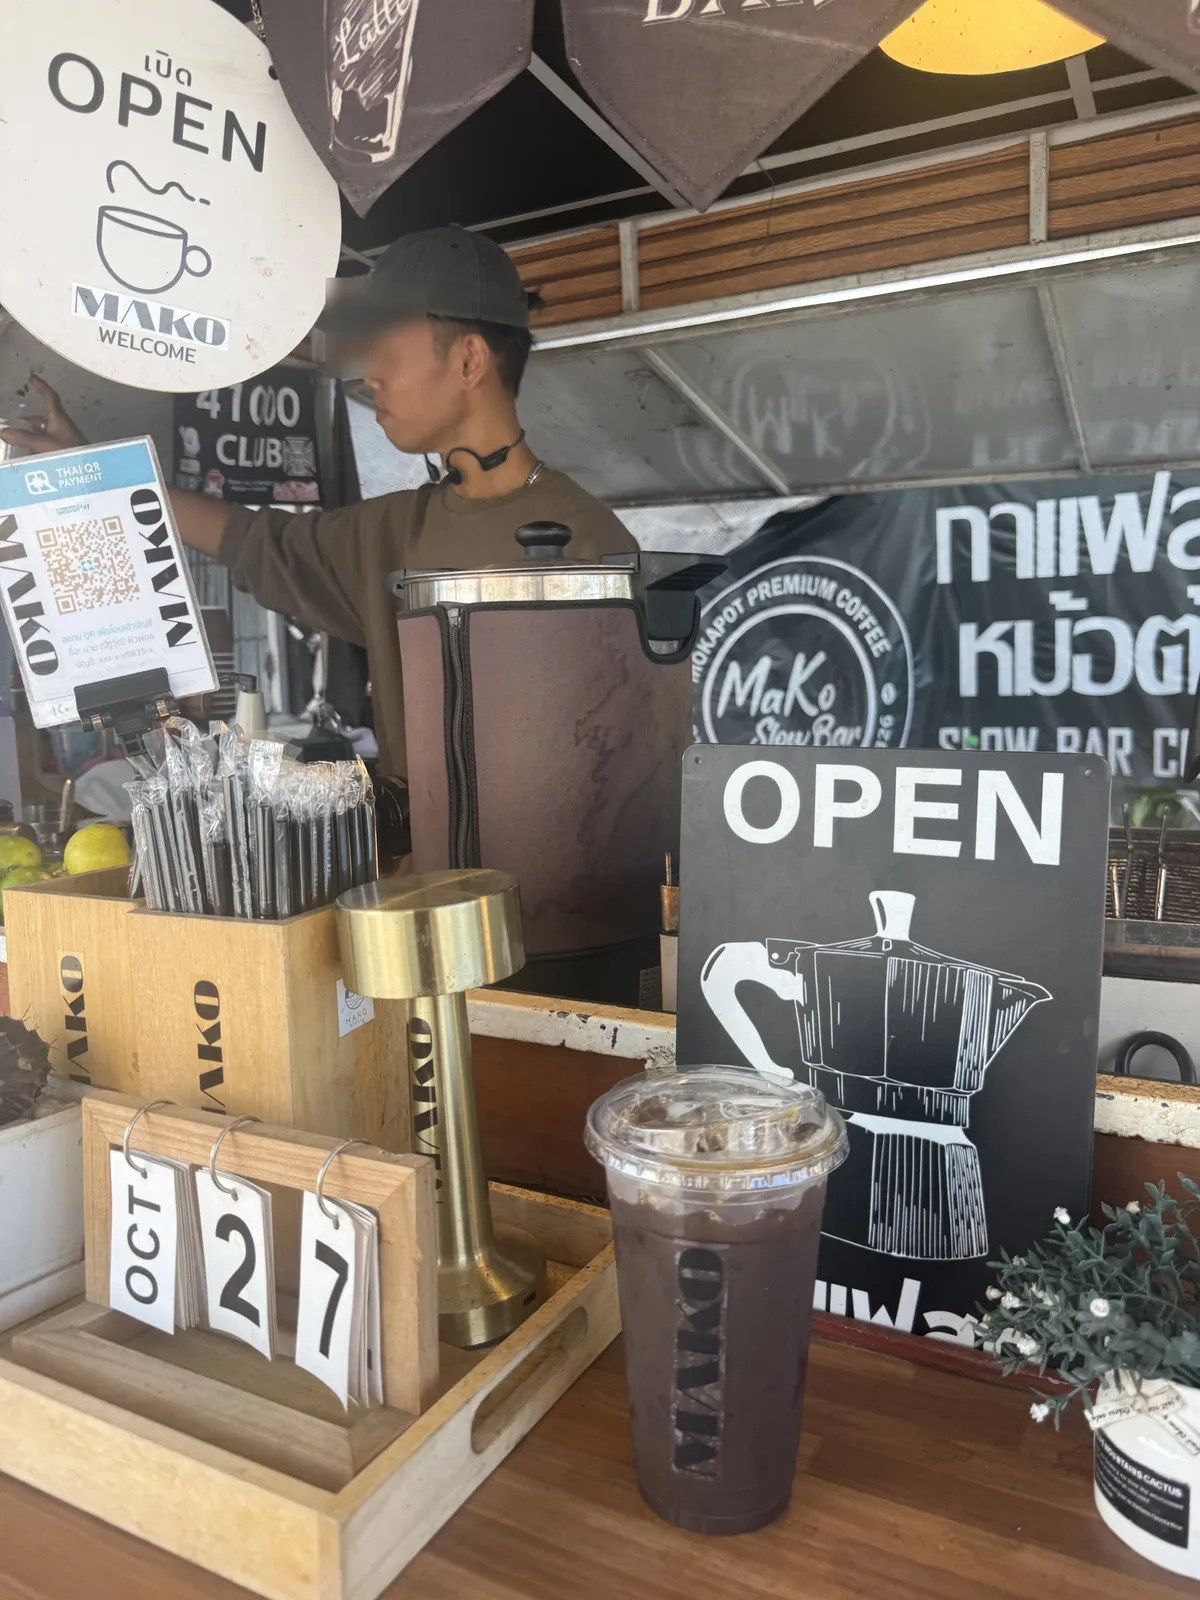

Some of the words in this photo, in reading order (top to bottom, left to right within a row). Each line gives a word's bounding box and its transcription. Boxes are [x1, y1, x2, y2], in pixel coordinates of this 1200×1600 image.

[144, 50, 192, 87] เปิด
[48, 52, 266, 173] OPEN
[74, 286, 226, 346] MAKO
[98, 326, 197, 363] WELCOME
[55, 464, 83, 478] THAI
[84, 461, 101, 473] QR
[58, 472, 103, 488] PAYMENT
[216, 434, 283, 468] CLUB
[130, 488, 197, 648] MAKO
[746, 574, 838, 608] PREMIUM
[836, 588, 892, 658] COFFEE
[723, 760, 1064, 866] OPEN
[60, 955, 91, 1085] AKO
[194, 980, 226, 1115] AKO
[125, 1184, 161, 1305] OCT
[215, 1213, 261, 1328] 2
[315, 1239, 349, 1360] 7
[1142, 1473, 1184, 1499] CACTUS
